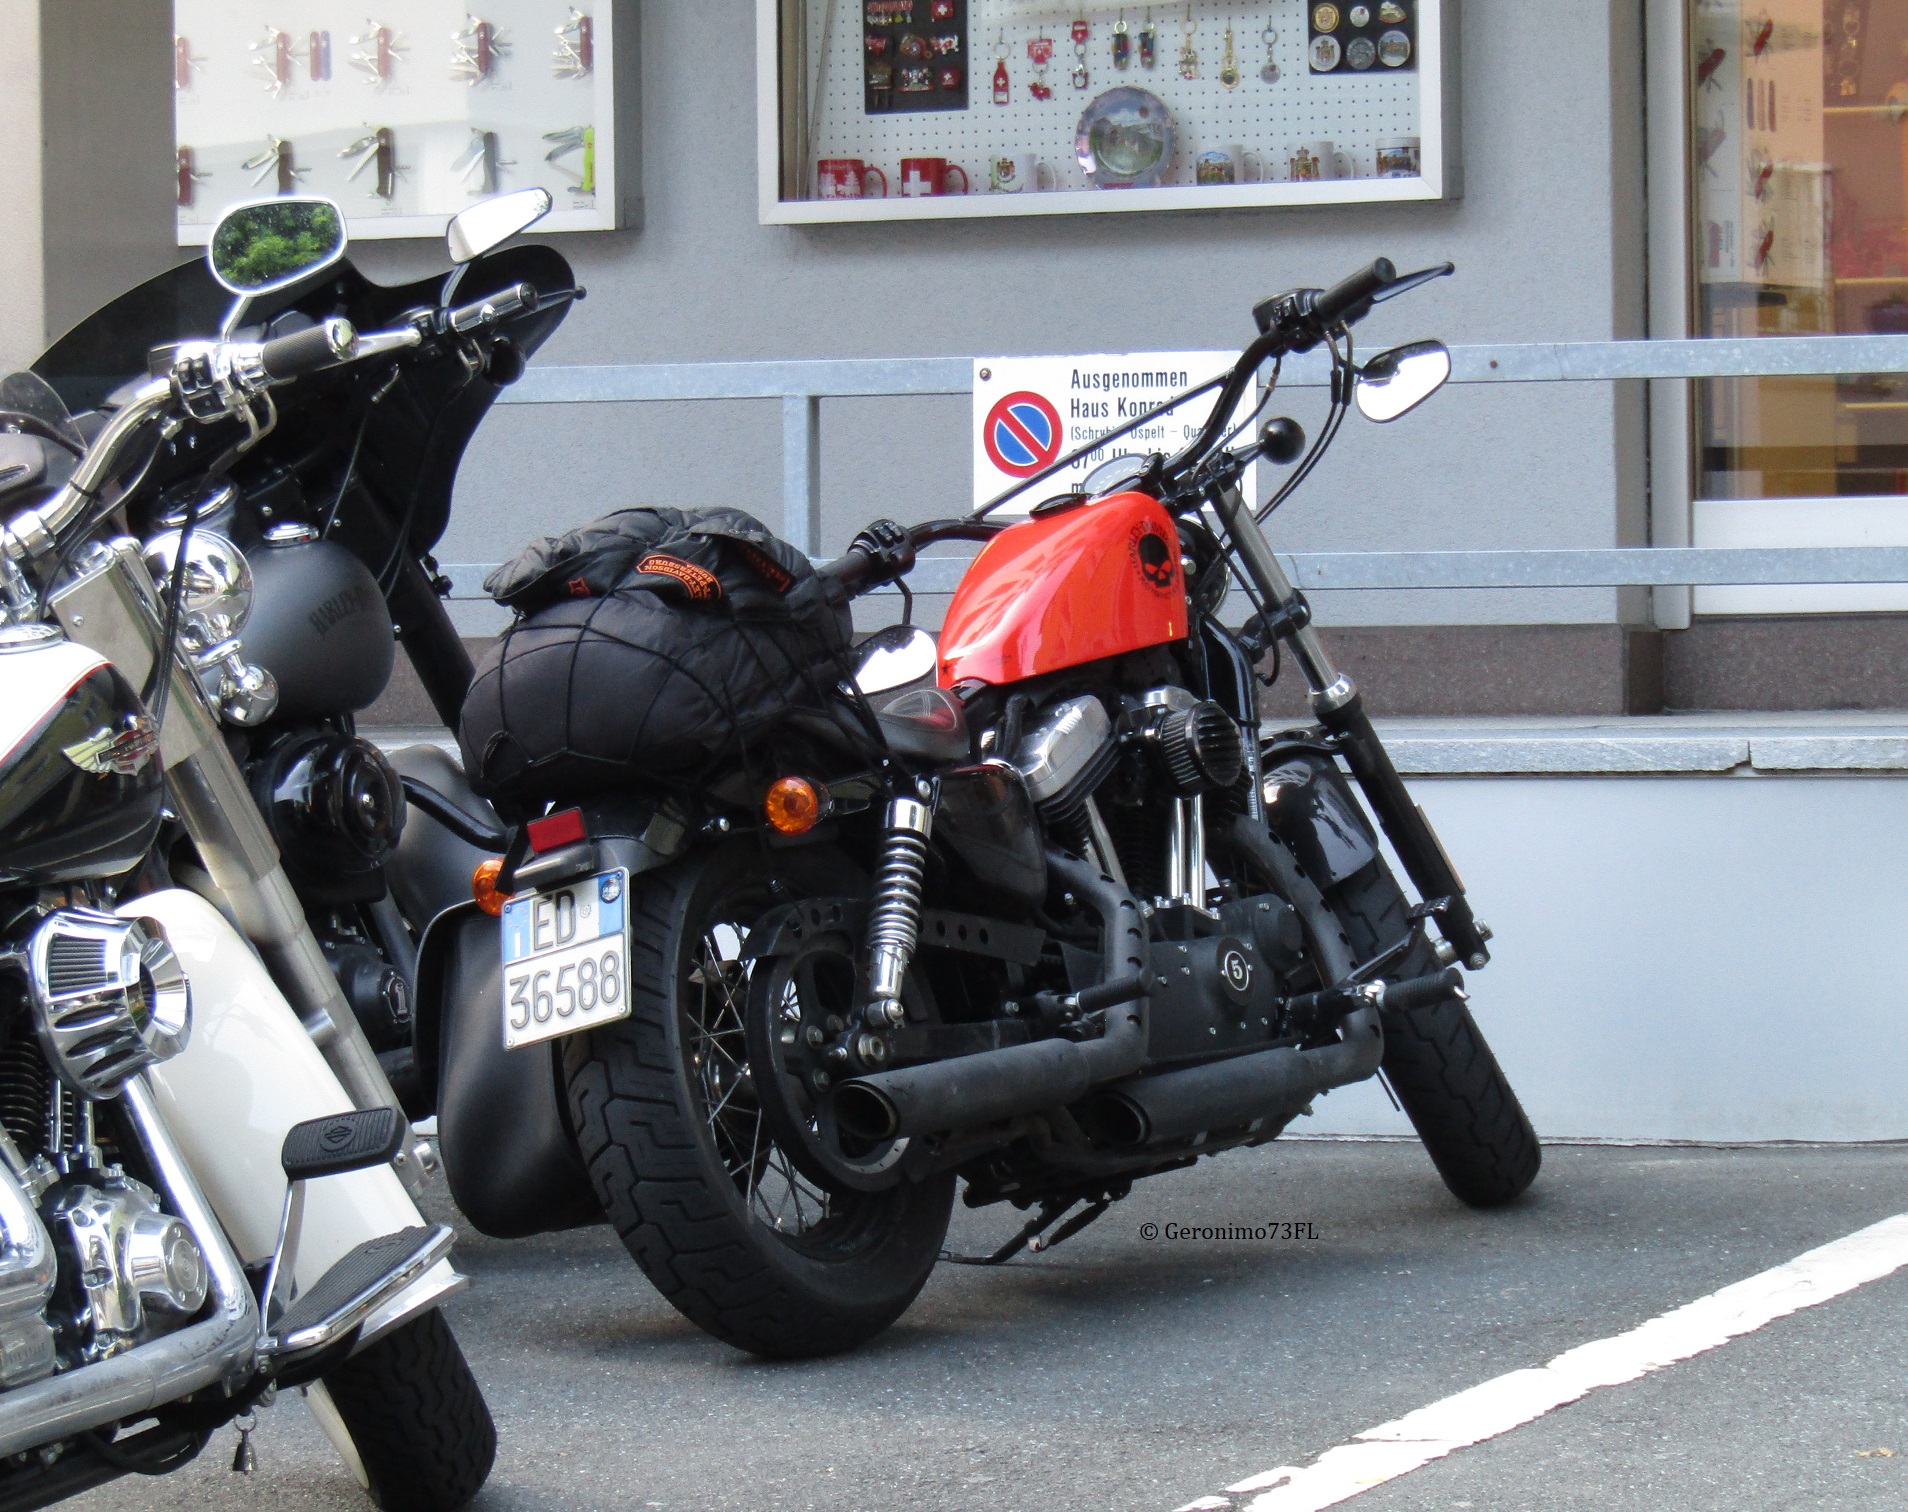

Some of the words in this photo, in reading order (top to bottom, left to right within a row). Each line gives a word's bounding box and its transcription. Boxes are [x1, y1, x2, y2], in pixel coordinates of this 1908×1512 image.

[1070, 369, 1188, 392] Ausgenommen
[1070, 398, 1109, 418] Haus
[1117, 397, 1174, 416] Konr
[533, 889, 577, 951] ED
[1230, 959, 1244, 980] 5
[509, 950, 620, 1030] 36588
